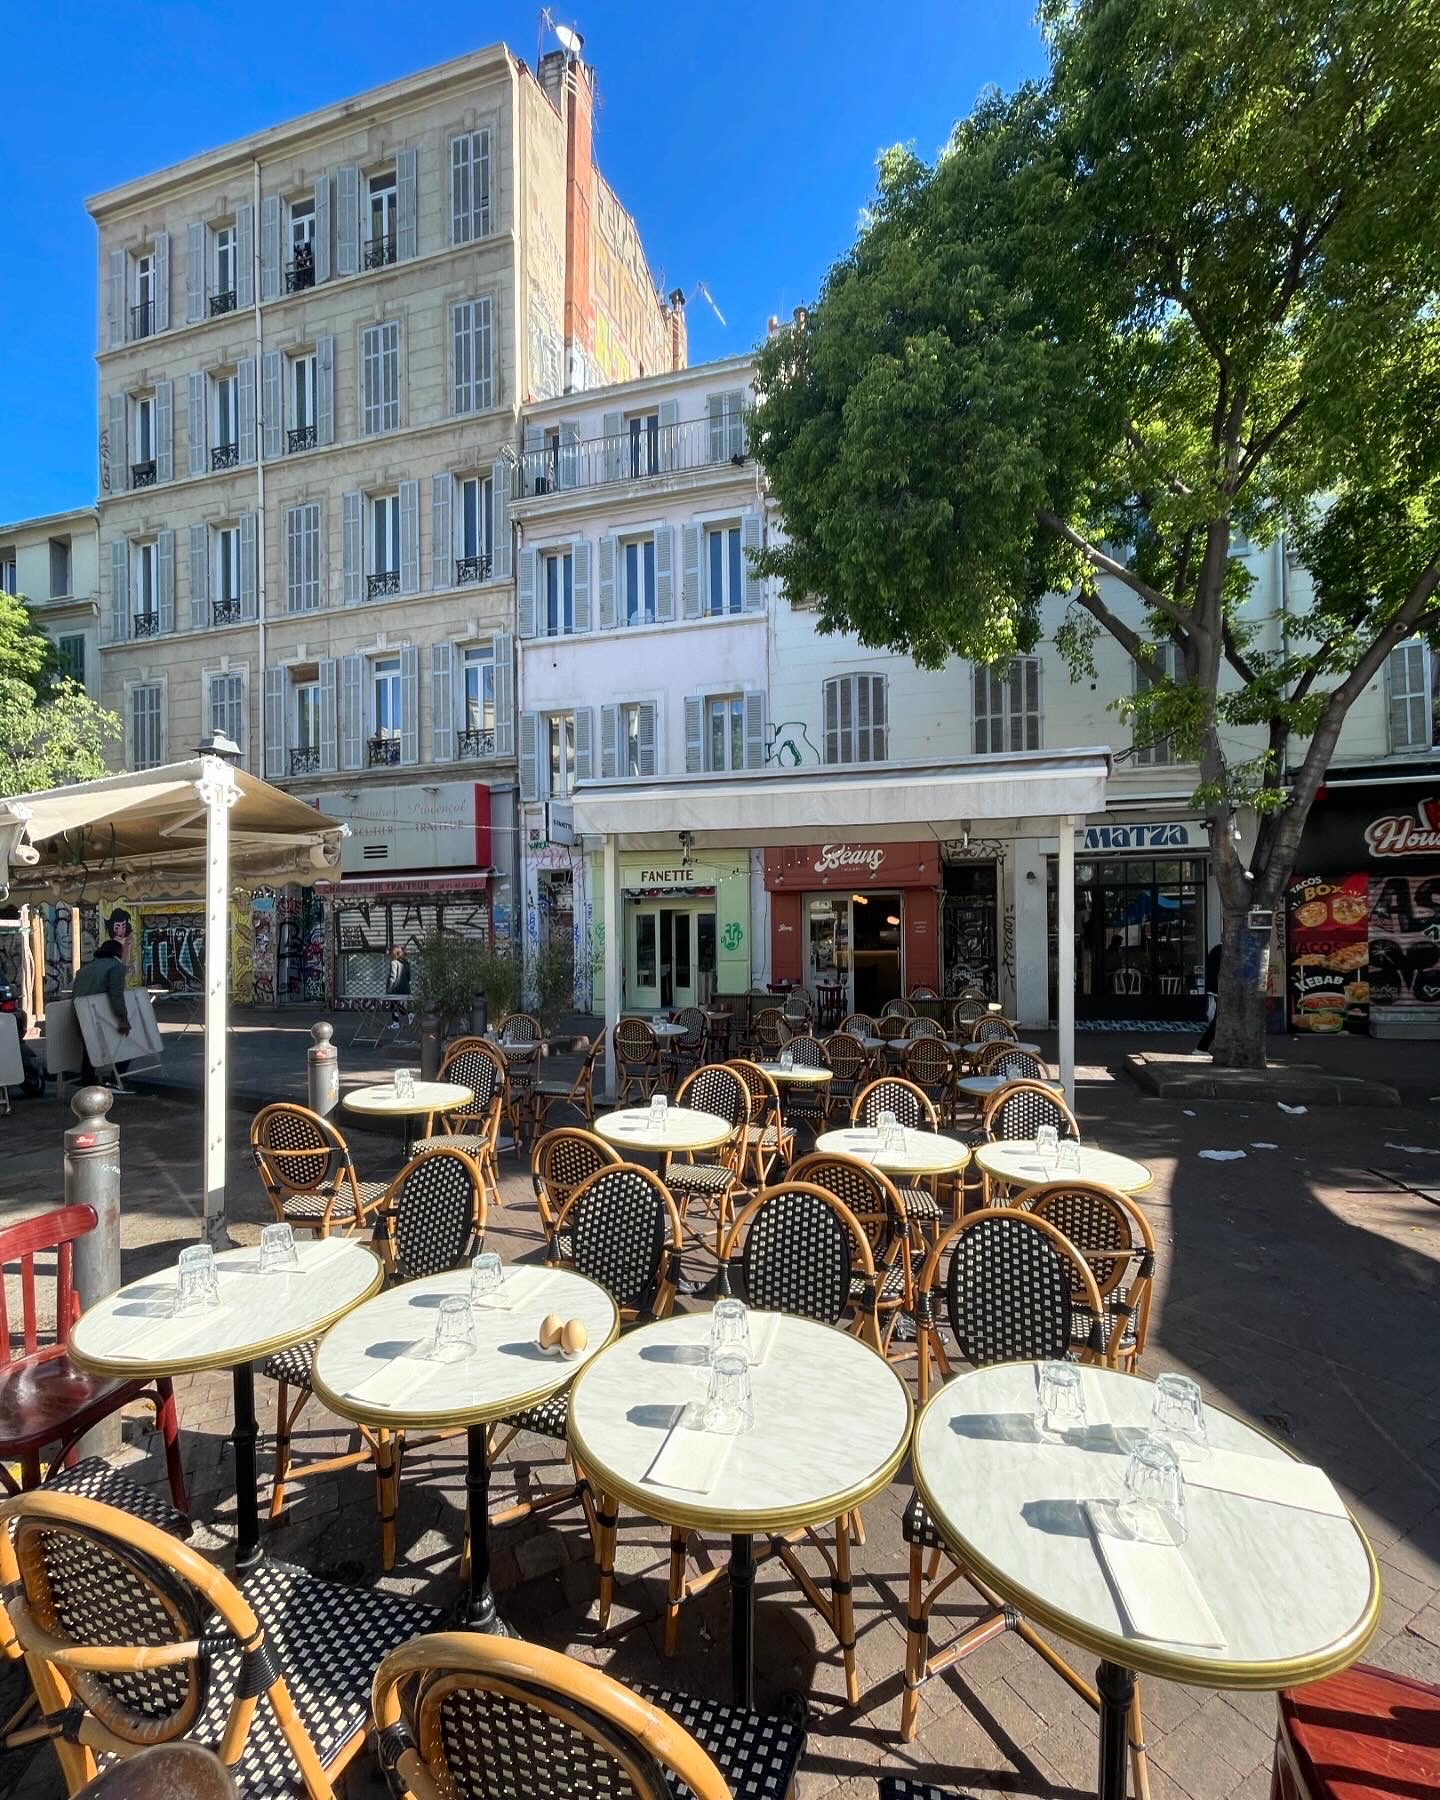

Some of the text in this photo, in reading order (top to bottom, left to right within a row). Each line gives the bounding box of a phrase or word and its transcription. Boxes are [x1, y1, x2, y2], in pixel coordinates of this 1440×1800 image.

[641, 869, 694, 882] FANETTE
[387, 879, 430, 891] TRAITEUR
[1290, 876, 1323, 894] TACOS
[1303, 884, 1346, 901] BOX
[1294, 975, 1345, 992] KEBAB
